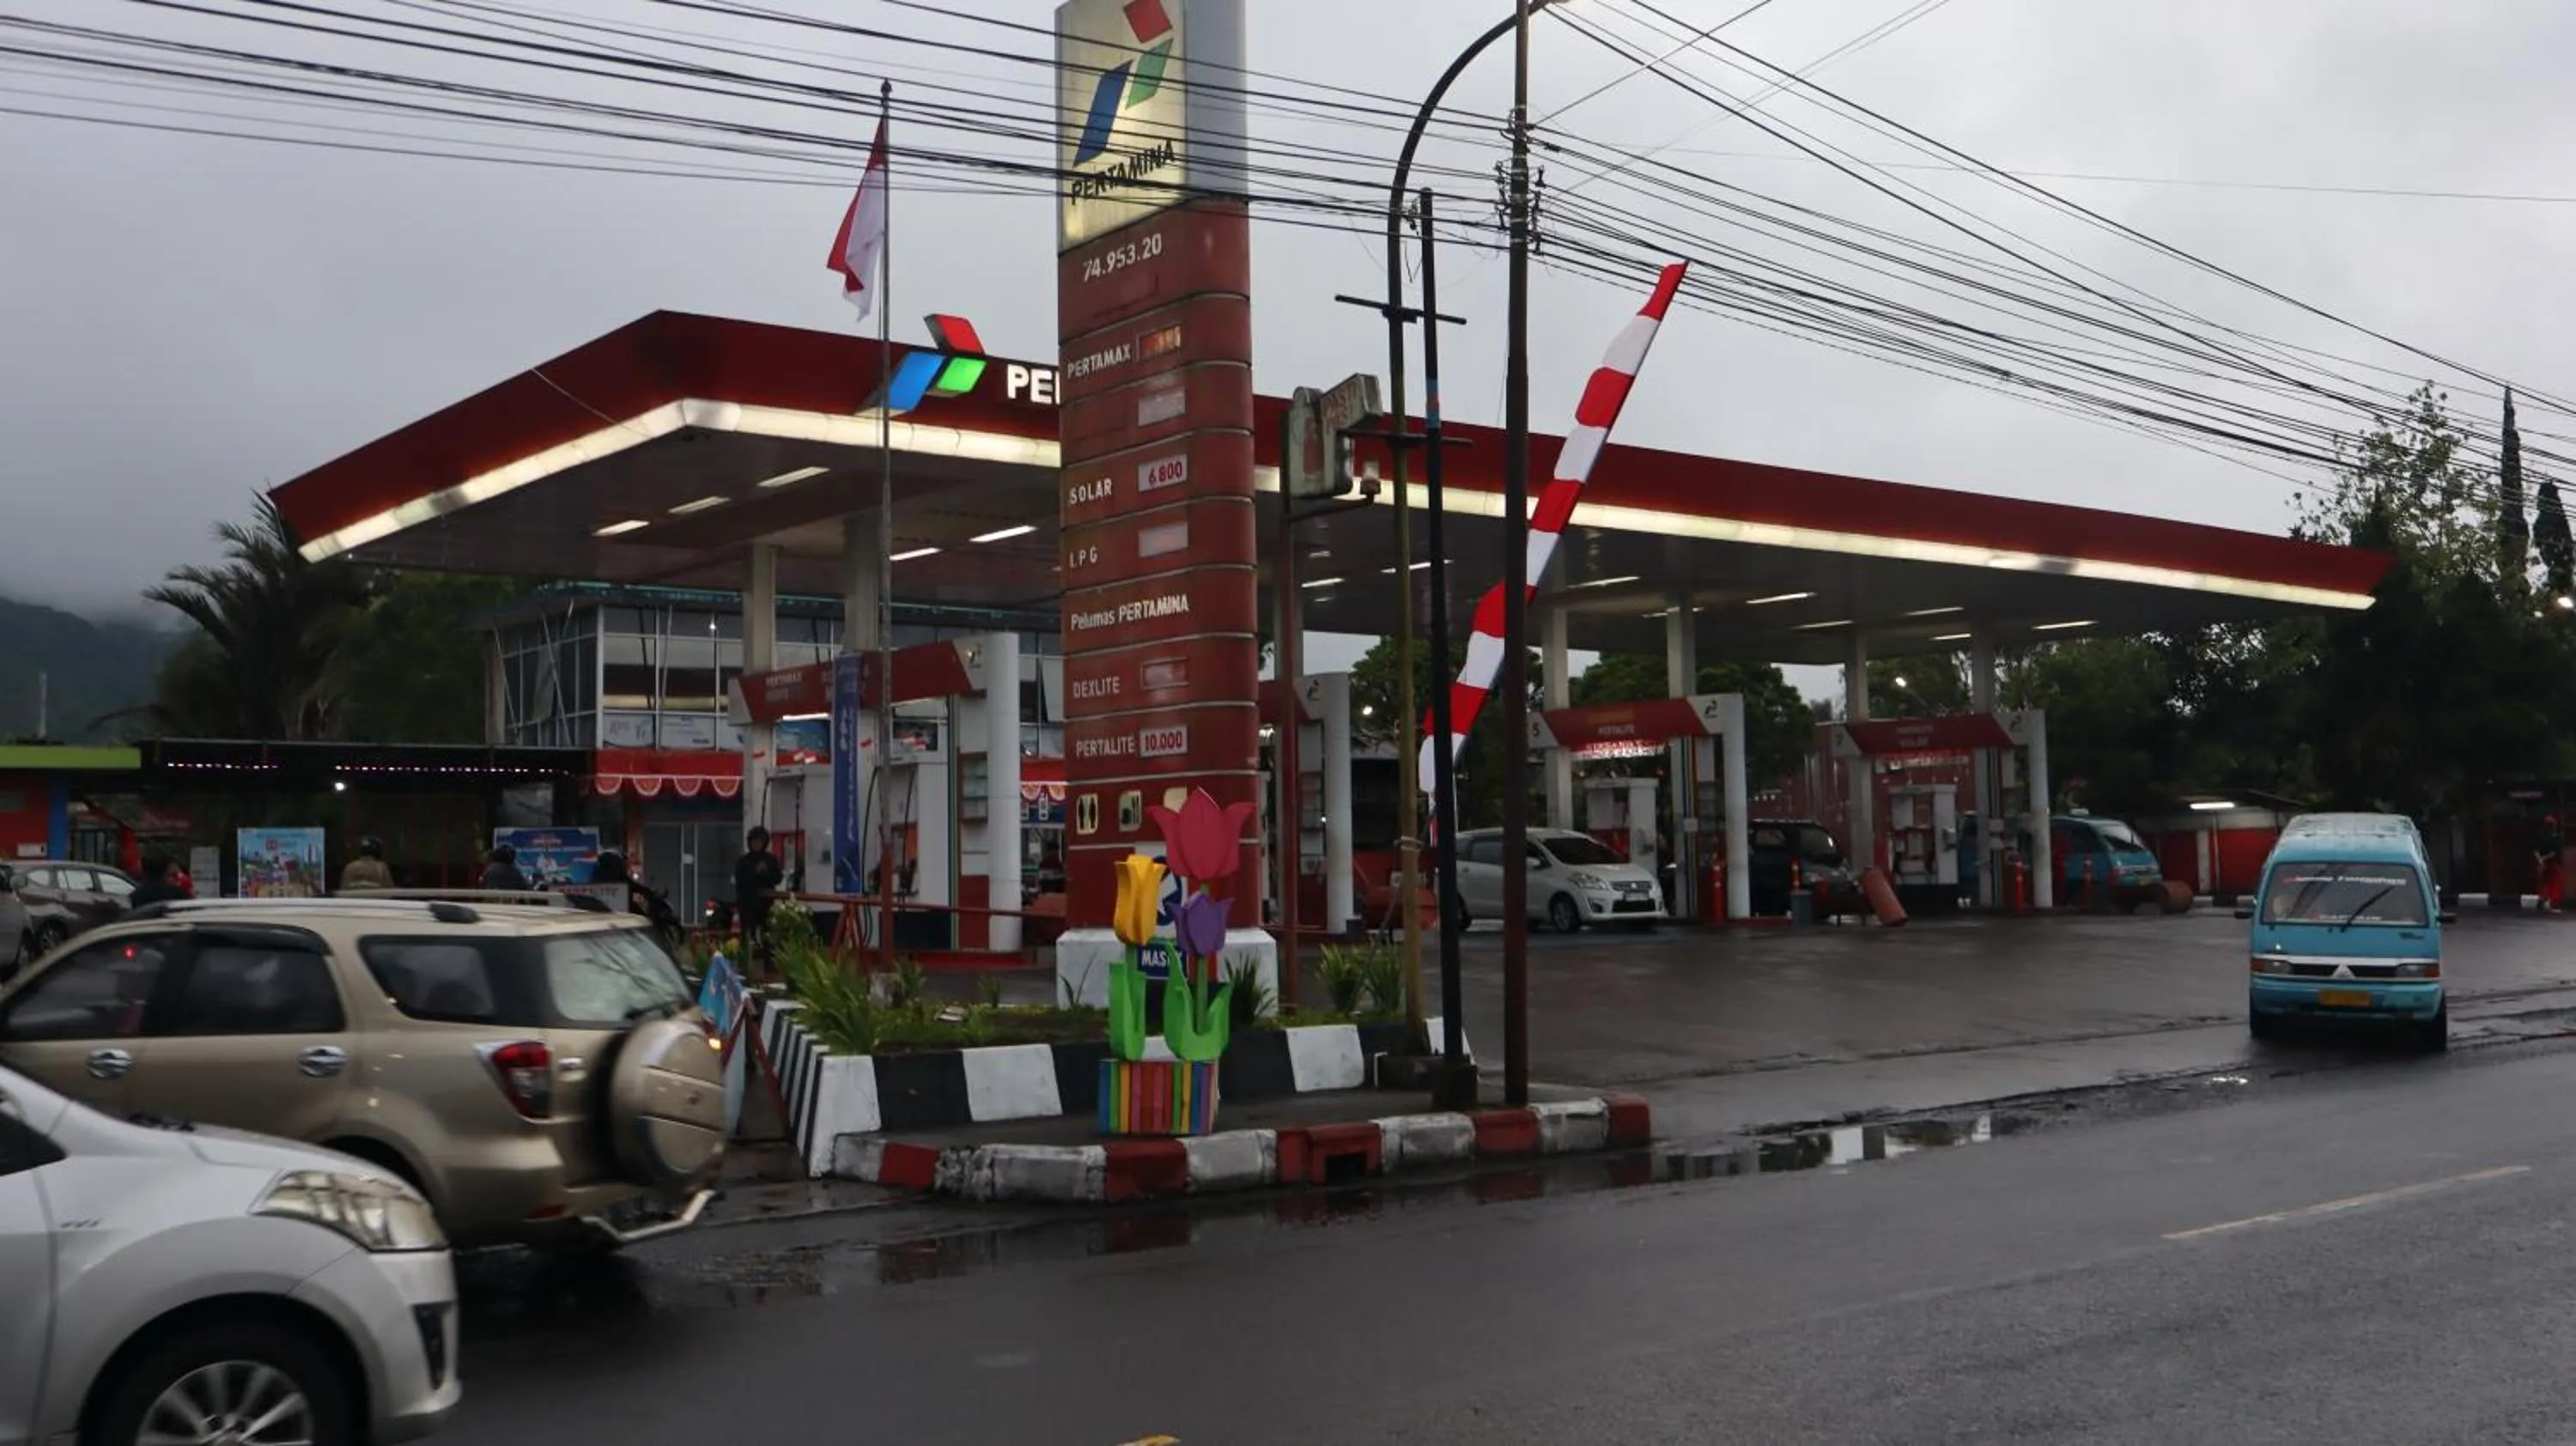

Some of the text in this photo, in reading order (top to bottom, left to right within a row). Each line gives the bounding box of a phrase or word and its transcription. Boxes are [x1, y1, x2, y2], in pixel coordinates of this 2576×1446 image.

[1072, 137, 1176, 205] PERTAMINA
[1083, 233, 1163, 282] 74.953.20
[1067, 343, 1132, 380] PERTAMAX
[1007, 363, 1060, 405] PE
[1069, 477, 1113, 505] SOLAR
[1071, 594, 1190, 631] Pelumas PERTAMINA
[1073, 676, 1121, 698] DEXLITE
[1076, 731, 1183, 757] PERTALITE 10.000
[1141, 949, 1183, 968] MAS
